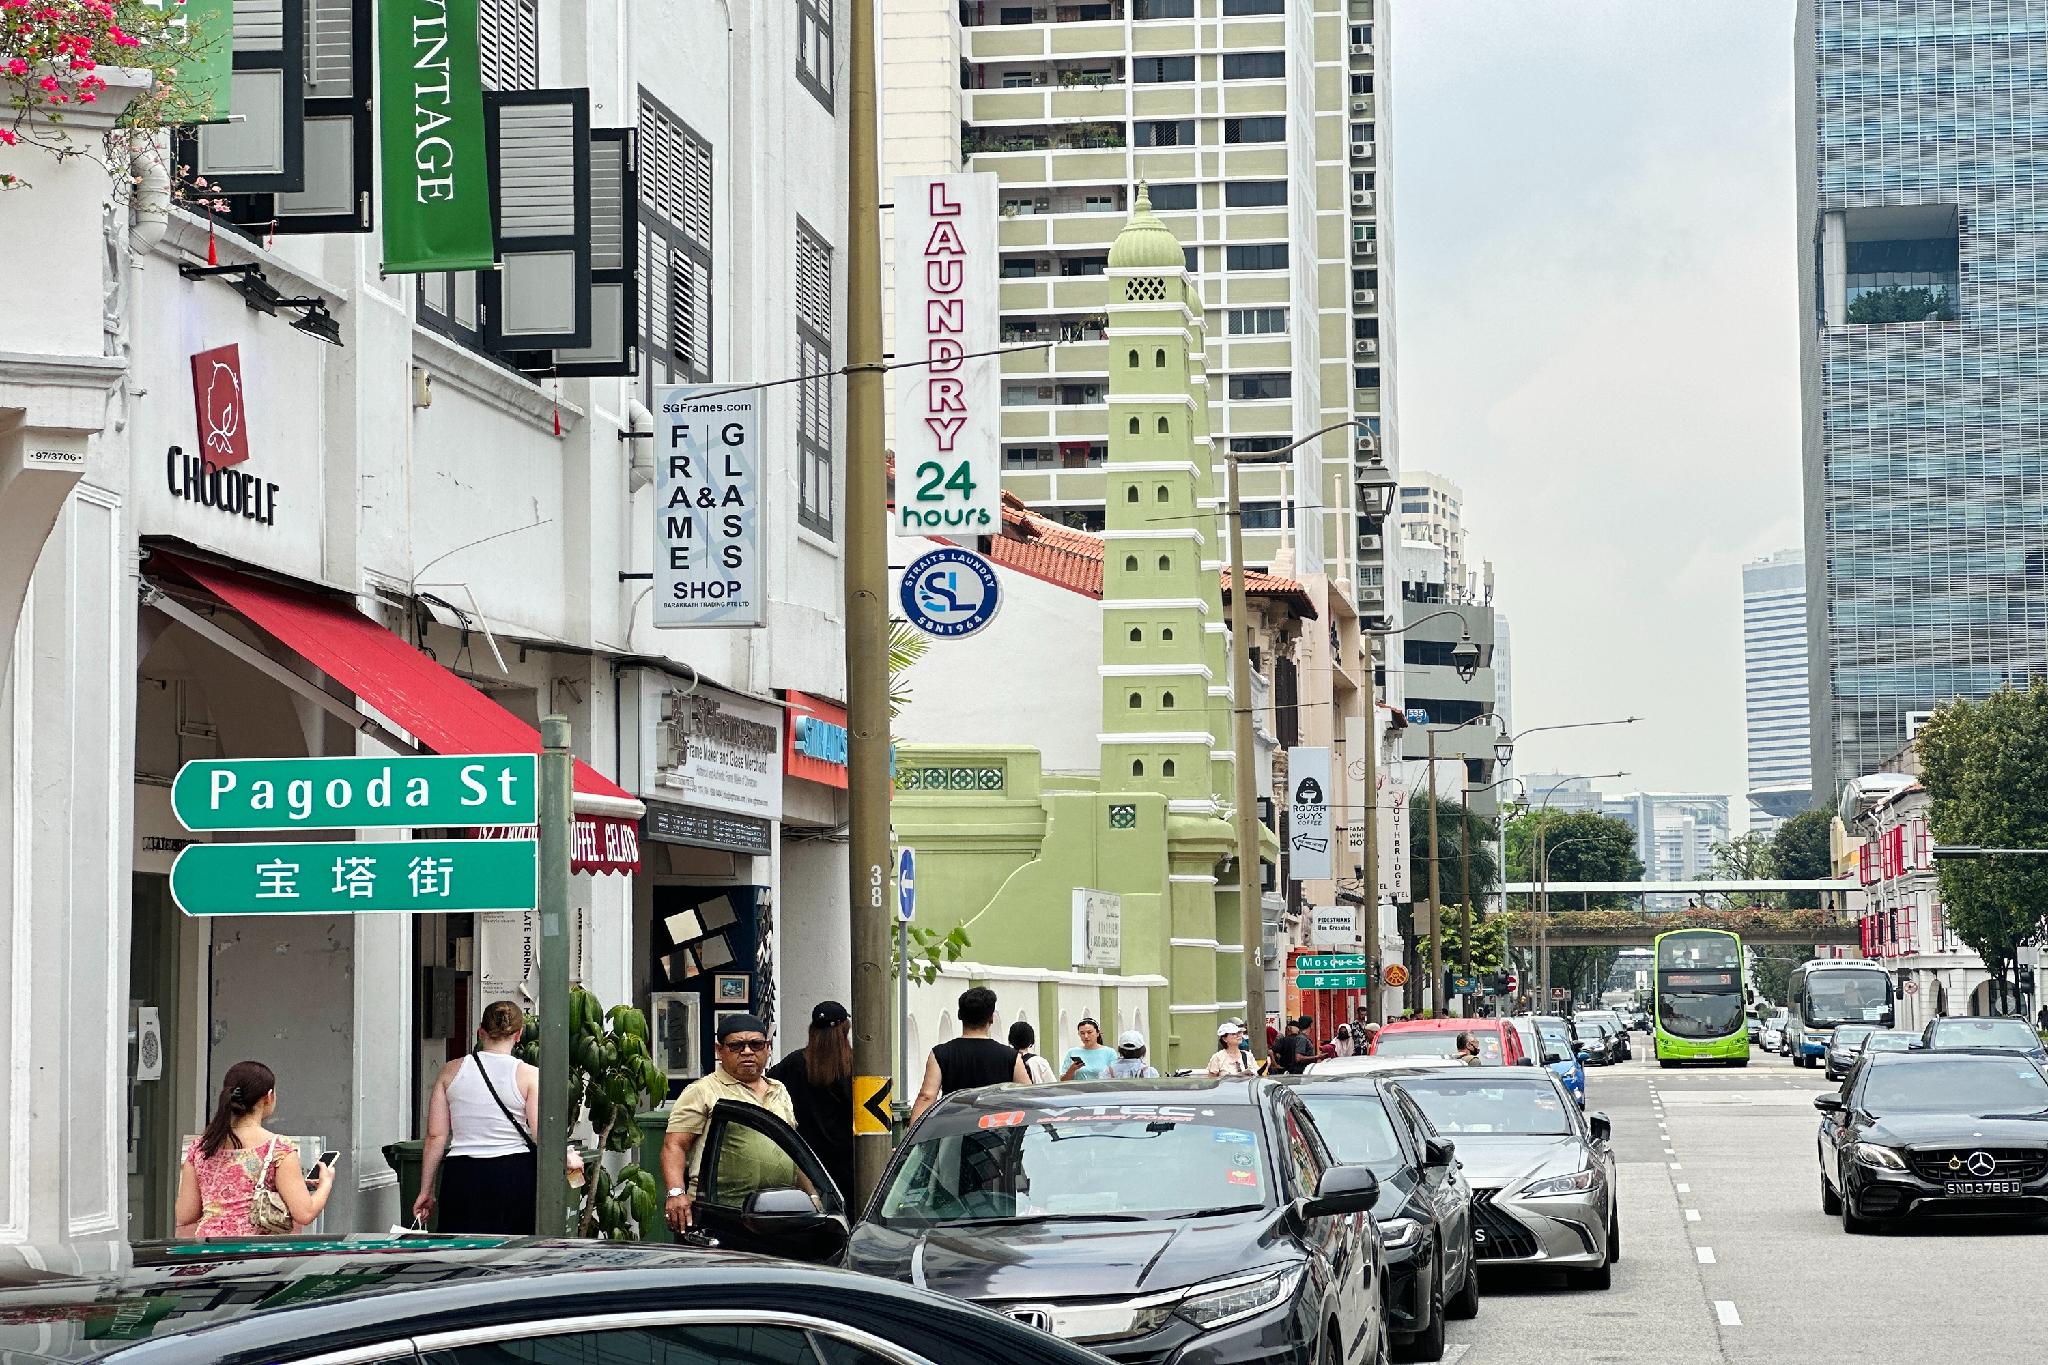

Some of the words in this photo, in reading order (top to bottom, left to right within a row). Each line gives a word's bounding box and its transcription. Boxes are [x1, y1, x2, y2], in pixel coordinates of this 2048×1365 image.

[924, 182, 967, 451] LAUNDRY
[662, 403, 752, 413] SGFrames.com
[167, 445, 280, 527] CHOCOELF
[667, 424, 693, 570] FRAME
[696, 486, 717, 509] &
[721, 422, 745, 569] GLASS
[916, 460, 977, 501] 24
[902, 505, 991, 527] hours
[904, 553, 946, 587] STRAITS
[951, 553, 996, 588] LAUNDRY
[673, 580, 742, 600] SHOP
[209, 766, 430, 820] Pagoda
[459, 765, 518, 807] St
[1293, 804, 1327, 813] ROUGH
[605, 823, 639, 862] GELATO
[254, 856, 455, 899] 宝塔街
[870, 864, 882, 908] 38
[523, 911, 532, 932] LATE
[1302, 957, 1353, 969] Mosque
[1356, 956, 1366, 967] S
[1038, 1105, 1197, 1117] VTEC
